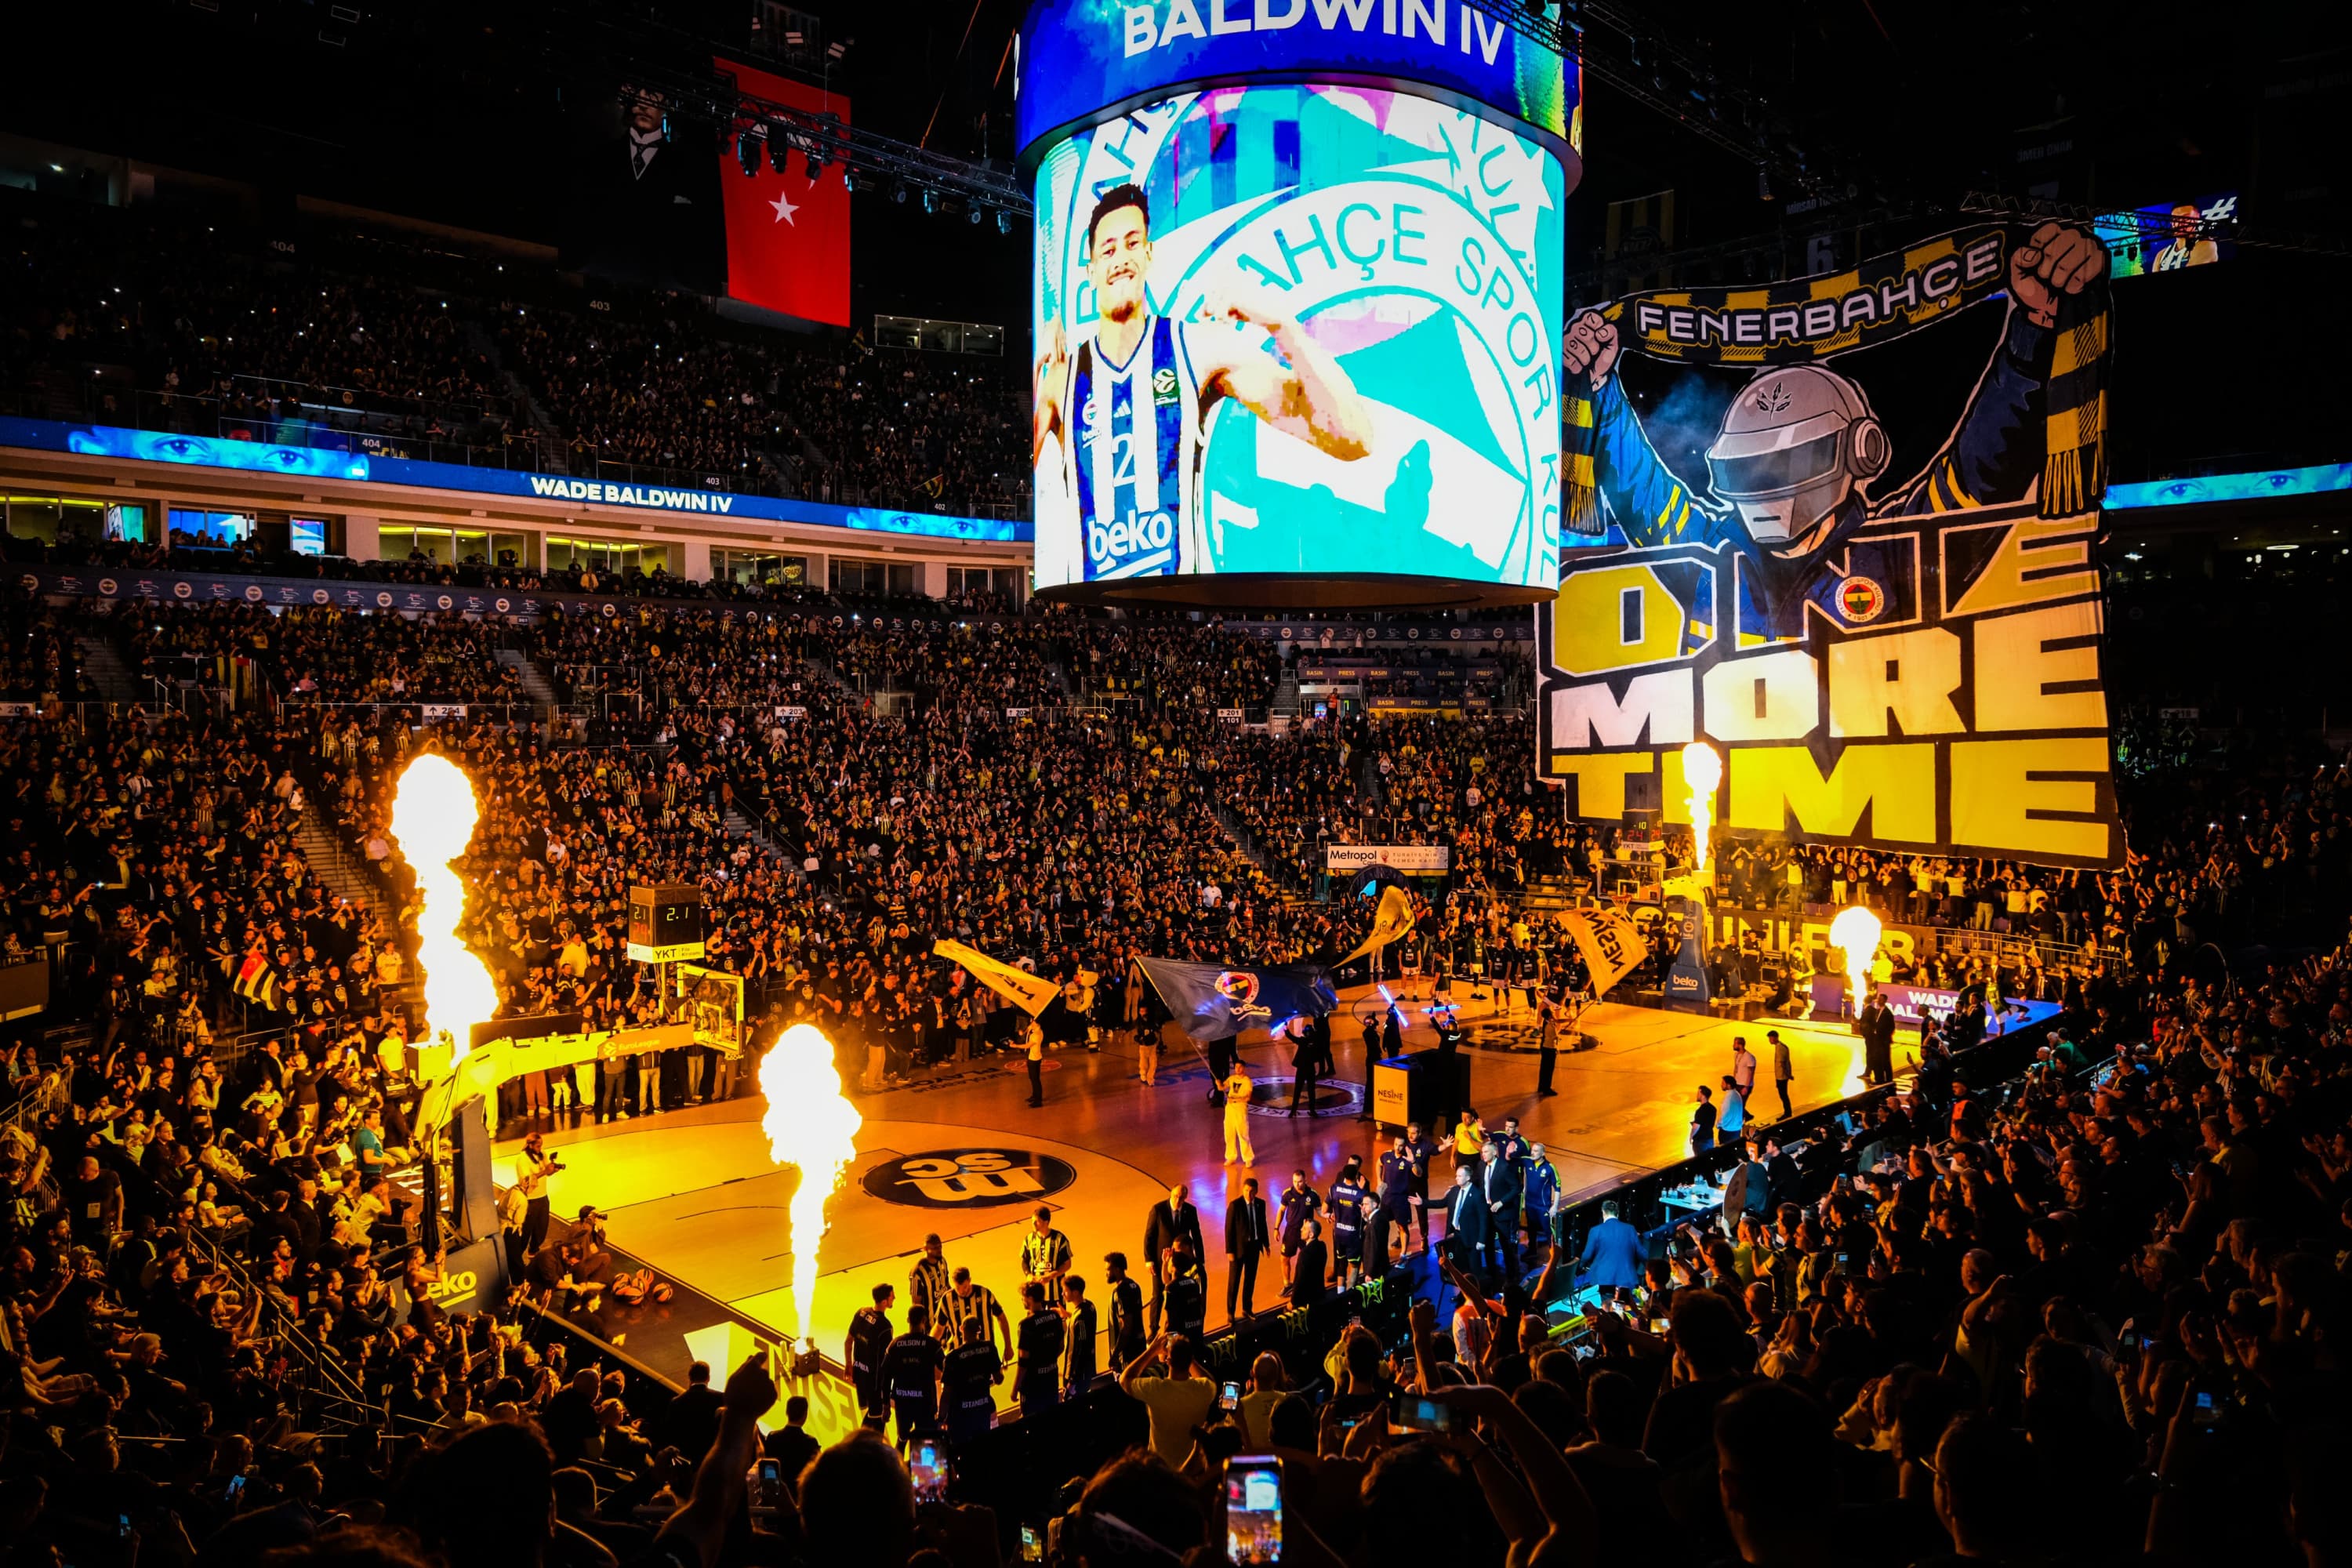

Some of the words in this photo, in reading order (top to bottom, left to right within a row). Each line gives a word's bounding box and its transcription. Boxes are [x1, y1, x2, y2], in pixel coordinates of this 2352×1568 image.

[1124, 0, 1446, 59] BALDWIN
[1461, 3, 1506, 66] IV
[1639, 240, 1998, 342] FENERBAHÇE
[590, 299, 611, 312] 403
[362, 438, 381, 448] 404
[706, 477, 720, 486] 403
[531, 476, 602, 501] WADE
[605, 485, 706, 511] BALDWIN
[711, 494, 733, 513] IV
[934, 503, 946, 511] 402
[1088, 509, 1173, 561] beko
[1551, 515, 2100, 676] ONE
[1552, 601, 2108, 748] MORE
[1553, 737, 2110, 858] TIME
[1330, 850, 1377, 862] Metropol
[666, 906, 689, 921] 2.1
[655, 948, 677, 959] YKT
[1673, 974, 1698, 988] beko
[405, 1270, 477, 1304] eko
